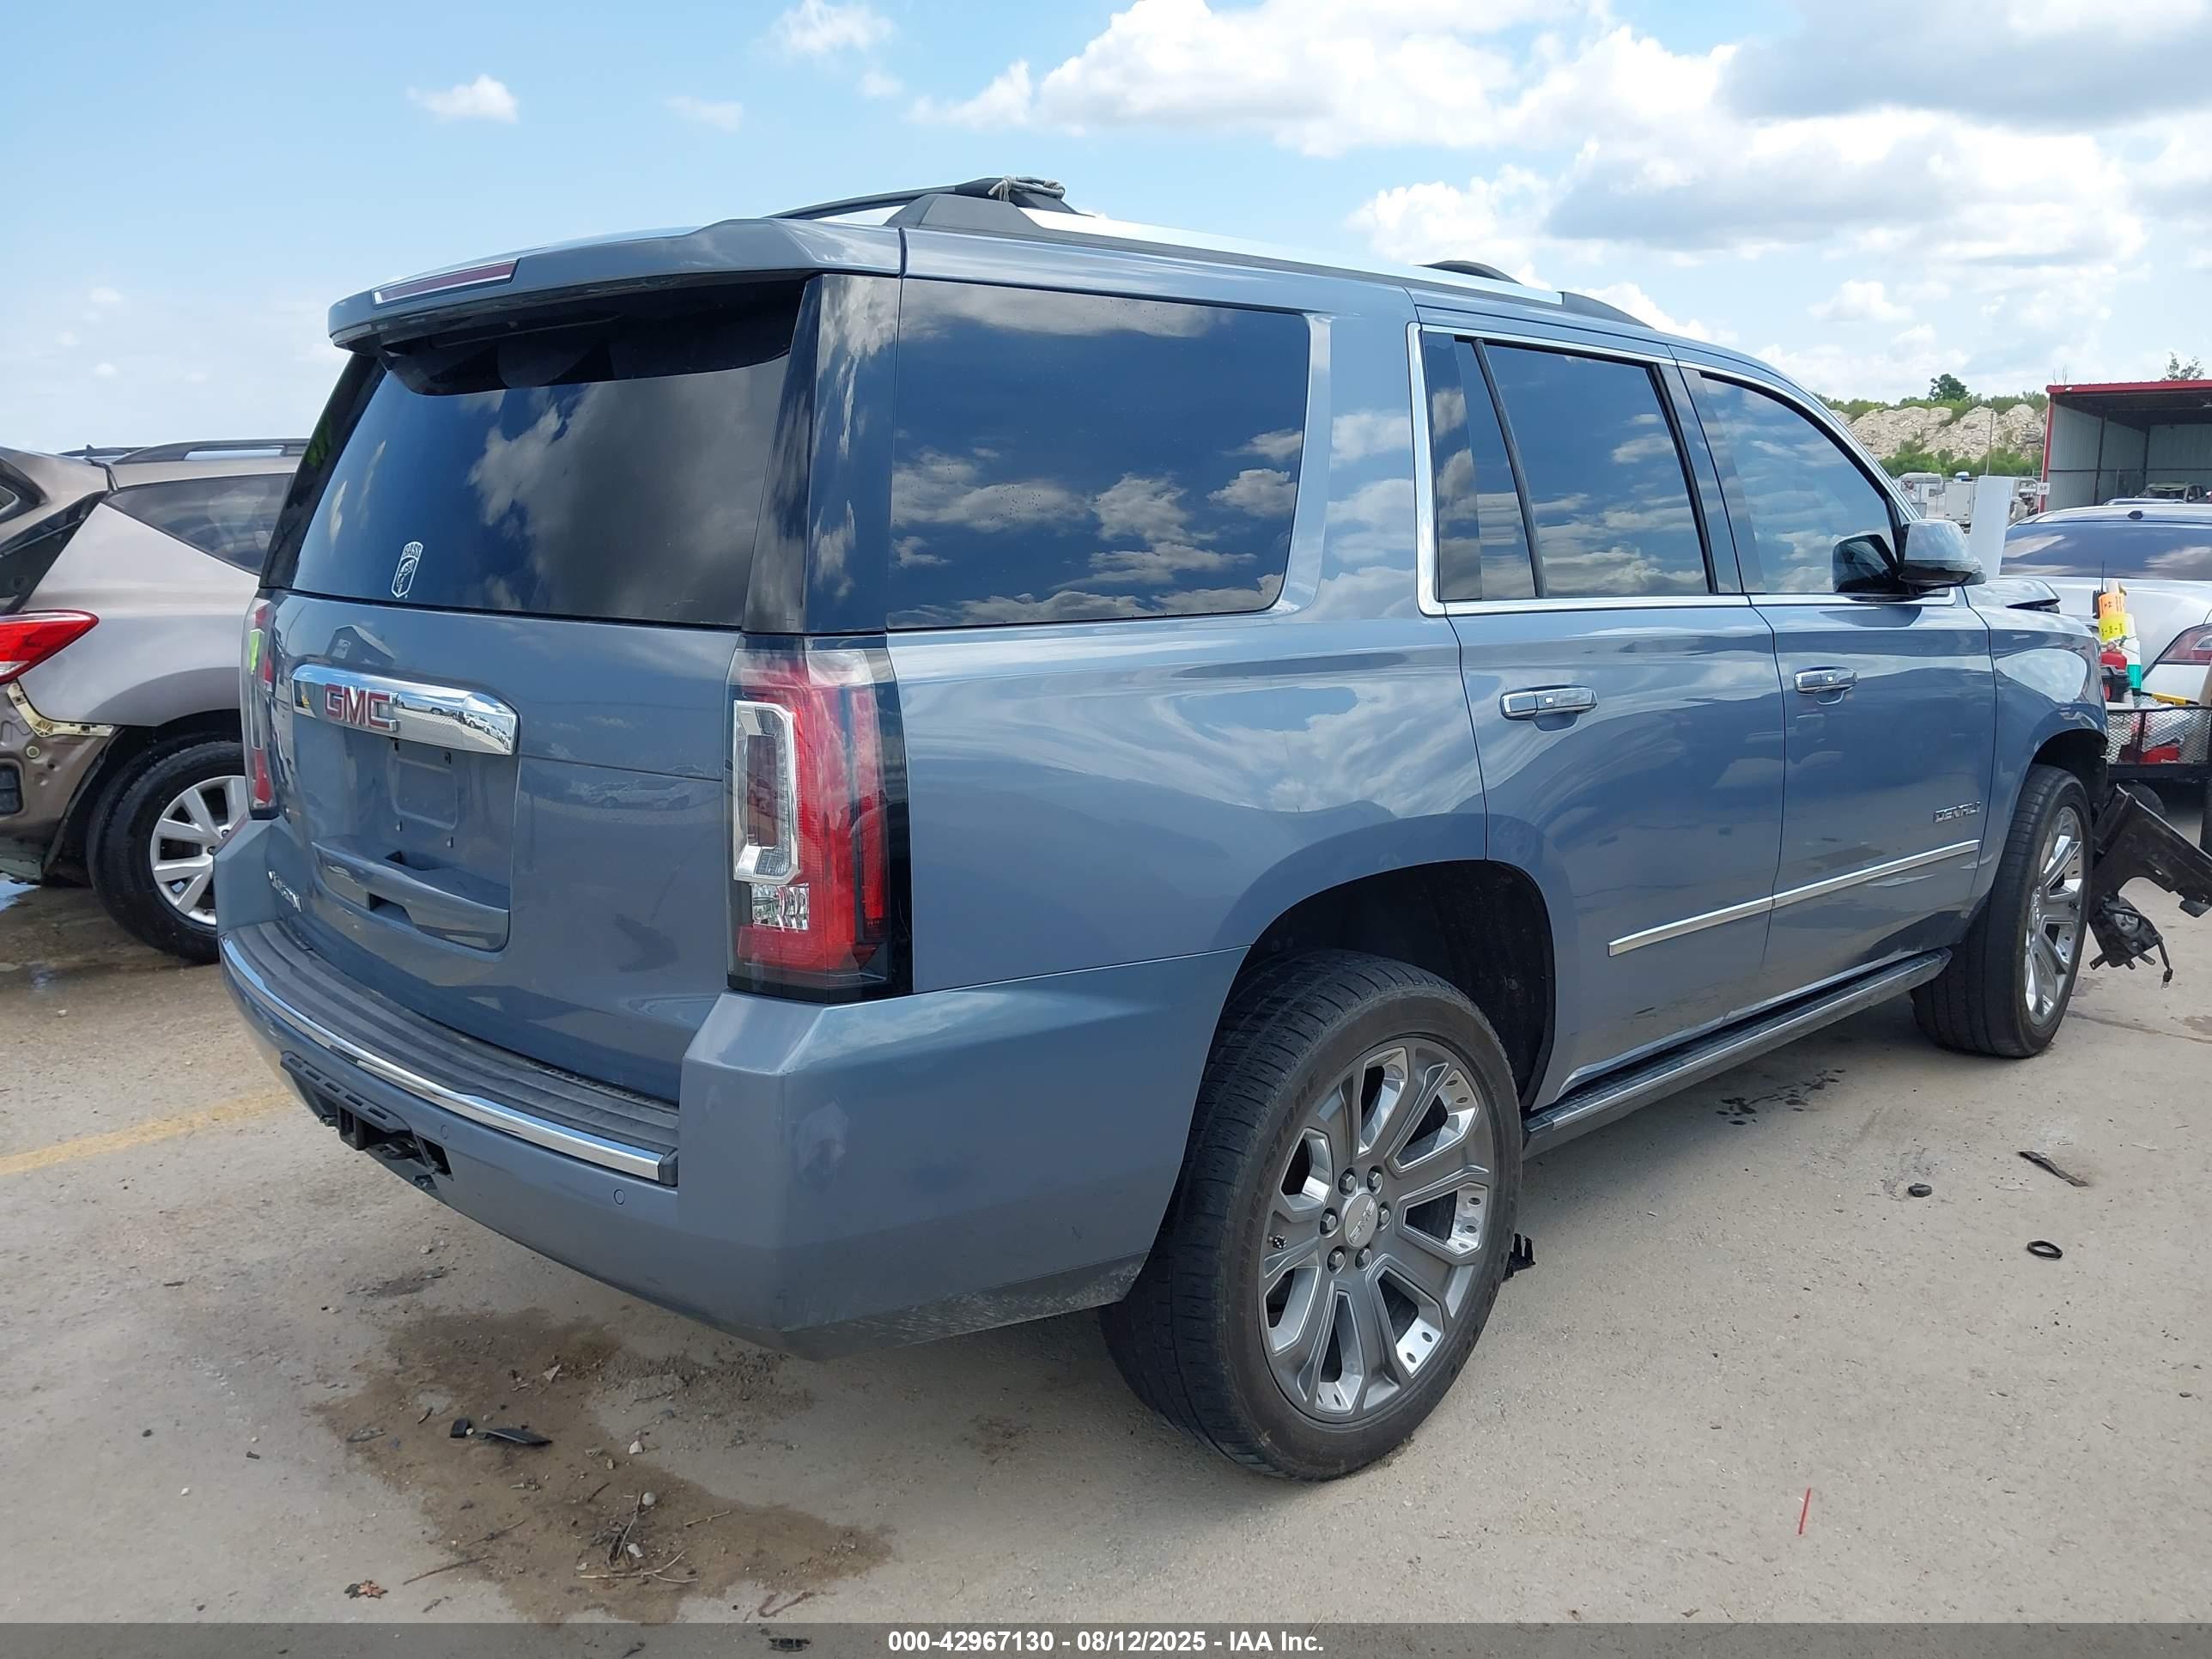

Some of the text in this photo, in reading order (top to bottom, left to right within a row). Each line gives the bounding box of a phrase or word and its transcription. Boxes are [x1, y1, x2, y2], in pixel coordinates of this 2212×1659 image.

[324, 683, 399, 732] GMC
[1933, 800, 1981, 823] DENALI
[1349, 1199, 1375, 1243] GMC
